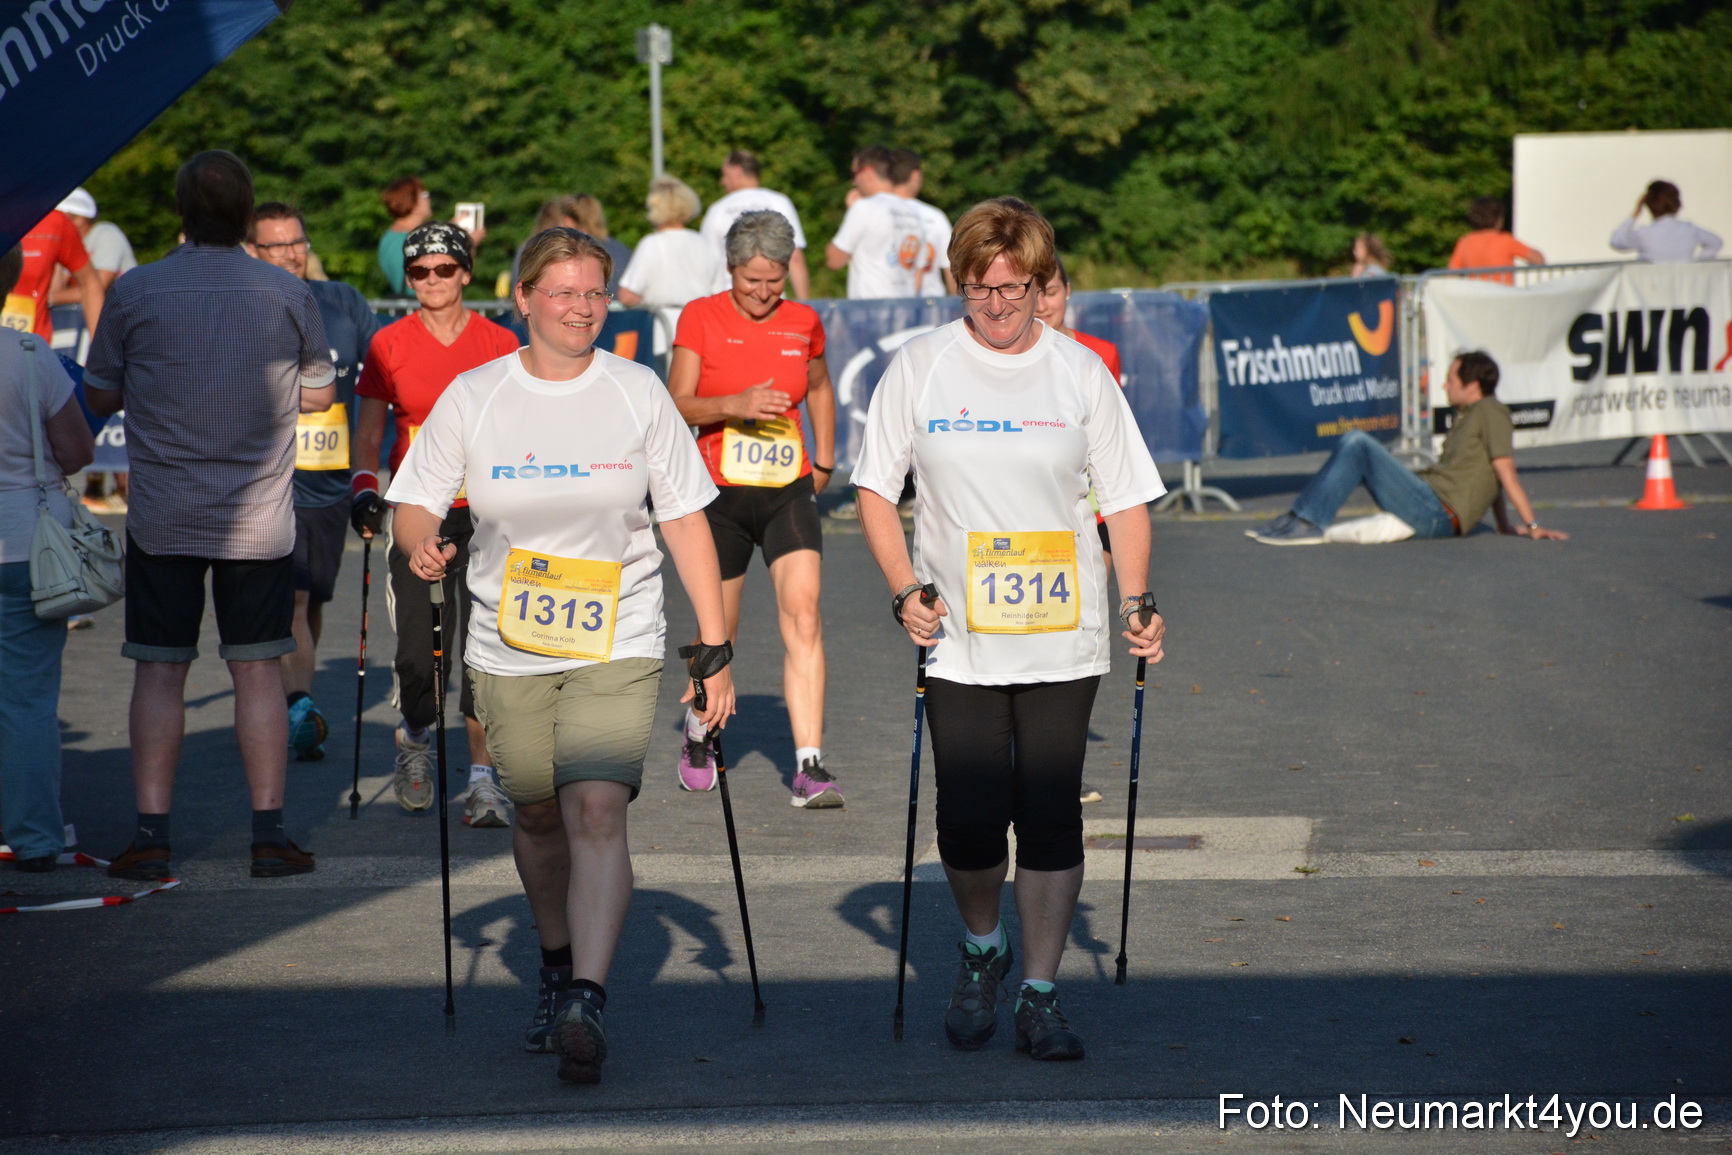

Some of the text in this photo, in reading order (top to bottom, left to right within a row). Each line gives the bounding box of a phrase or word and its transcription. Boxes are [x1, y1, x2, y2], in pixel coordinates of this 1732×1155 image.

[75, 1, 152, 77] Druck
[1568, 307, 1710, 383] swn
[1221, 334, 1362, 386] Frischmann
[1309, 380, 1343, 406] Druck
[1344, 380, 1366, 402] und
[1022, 419, 1066, 429] energie
[300, 430, 339, 452] 190
[732, 440, 795, 467] 1049
[590, 459, 633, 471] energie
[985, 548, 1025, 557] firmenlauf
[974, 559, 1007, 568] walken
[510, 575, 542, 588] walken
[521, 566, 563, 581] firmenlauf
[981, 572, 1070, 604] 1314
[513, 590, 604, 632] 1313
[1001, 611, 1049, 619] Reinhilde Graf
[531, 630, 576, 644] Corinna Kolb
